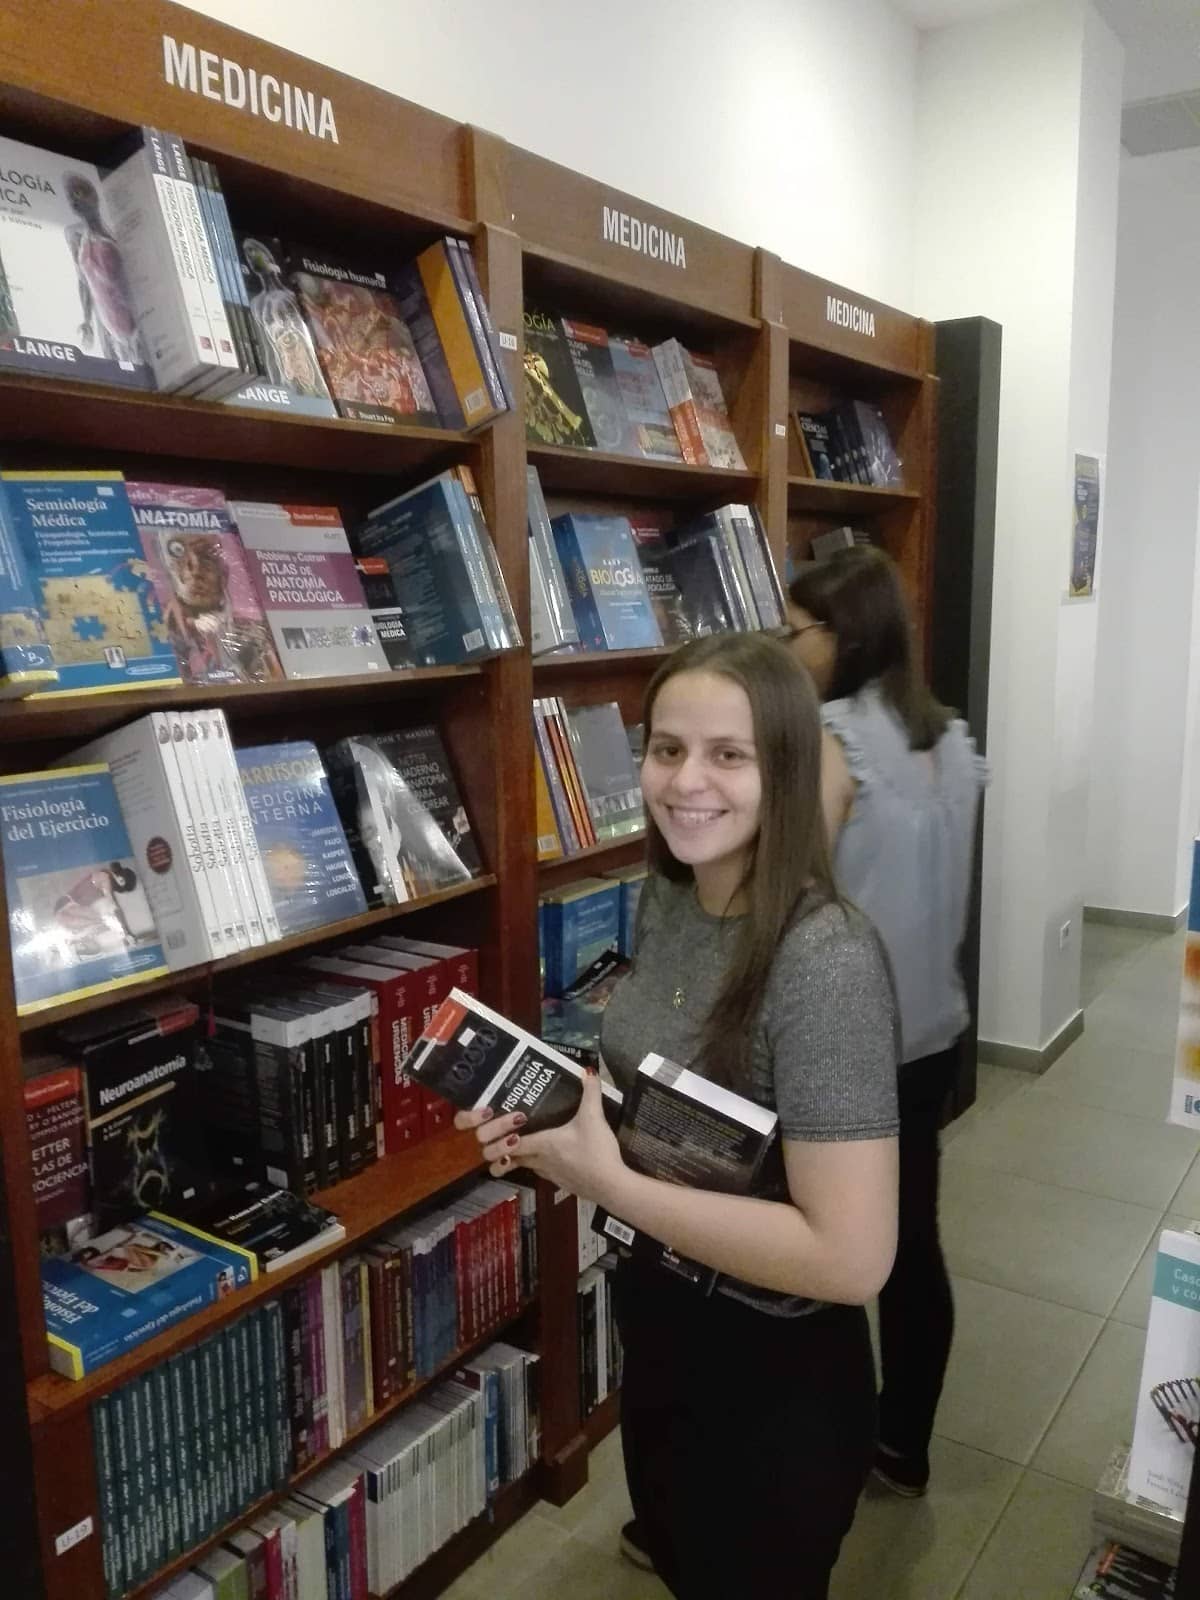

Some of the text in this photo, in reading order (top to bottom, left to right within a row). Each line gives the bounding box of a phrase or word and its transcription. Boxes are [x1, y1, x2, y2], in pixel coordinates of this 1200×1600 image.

[162, 34, 340, 145] MEDICINA
[603, 206, 686, 269] MEDICINA
[826, 295, 876, 338] MEDICINA
[13, 337, 77, 362] LANGE
[237, 387, 291, 404] ANGE
[25, 497, 108, 513] Semiología
[32, 513, 87, 528] Médica
[261, 561, 313, 576] ATLAS DE
[265, 574, 328, 590] ANATOMÍA
[1, 796, 86, 822] Fisiología
[250, 786, 327, 810] EDICINA
[250, 801, 323, 825] NTERNA
[7, 812, 109, 842] del Ejercicio
[99, 1054, 187, 1106] Neuroanatomía
[501, 1058, 544, 1112] FISIOLOGÍA
[522, 1067, 556, 1107] MÉDICA
[32, 1137, 71, 1161] ETTER
[57, 1153, 73, 1167] DE
